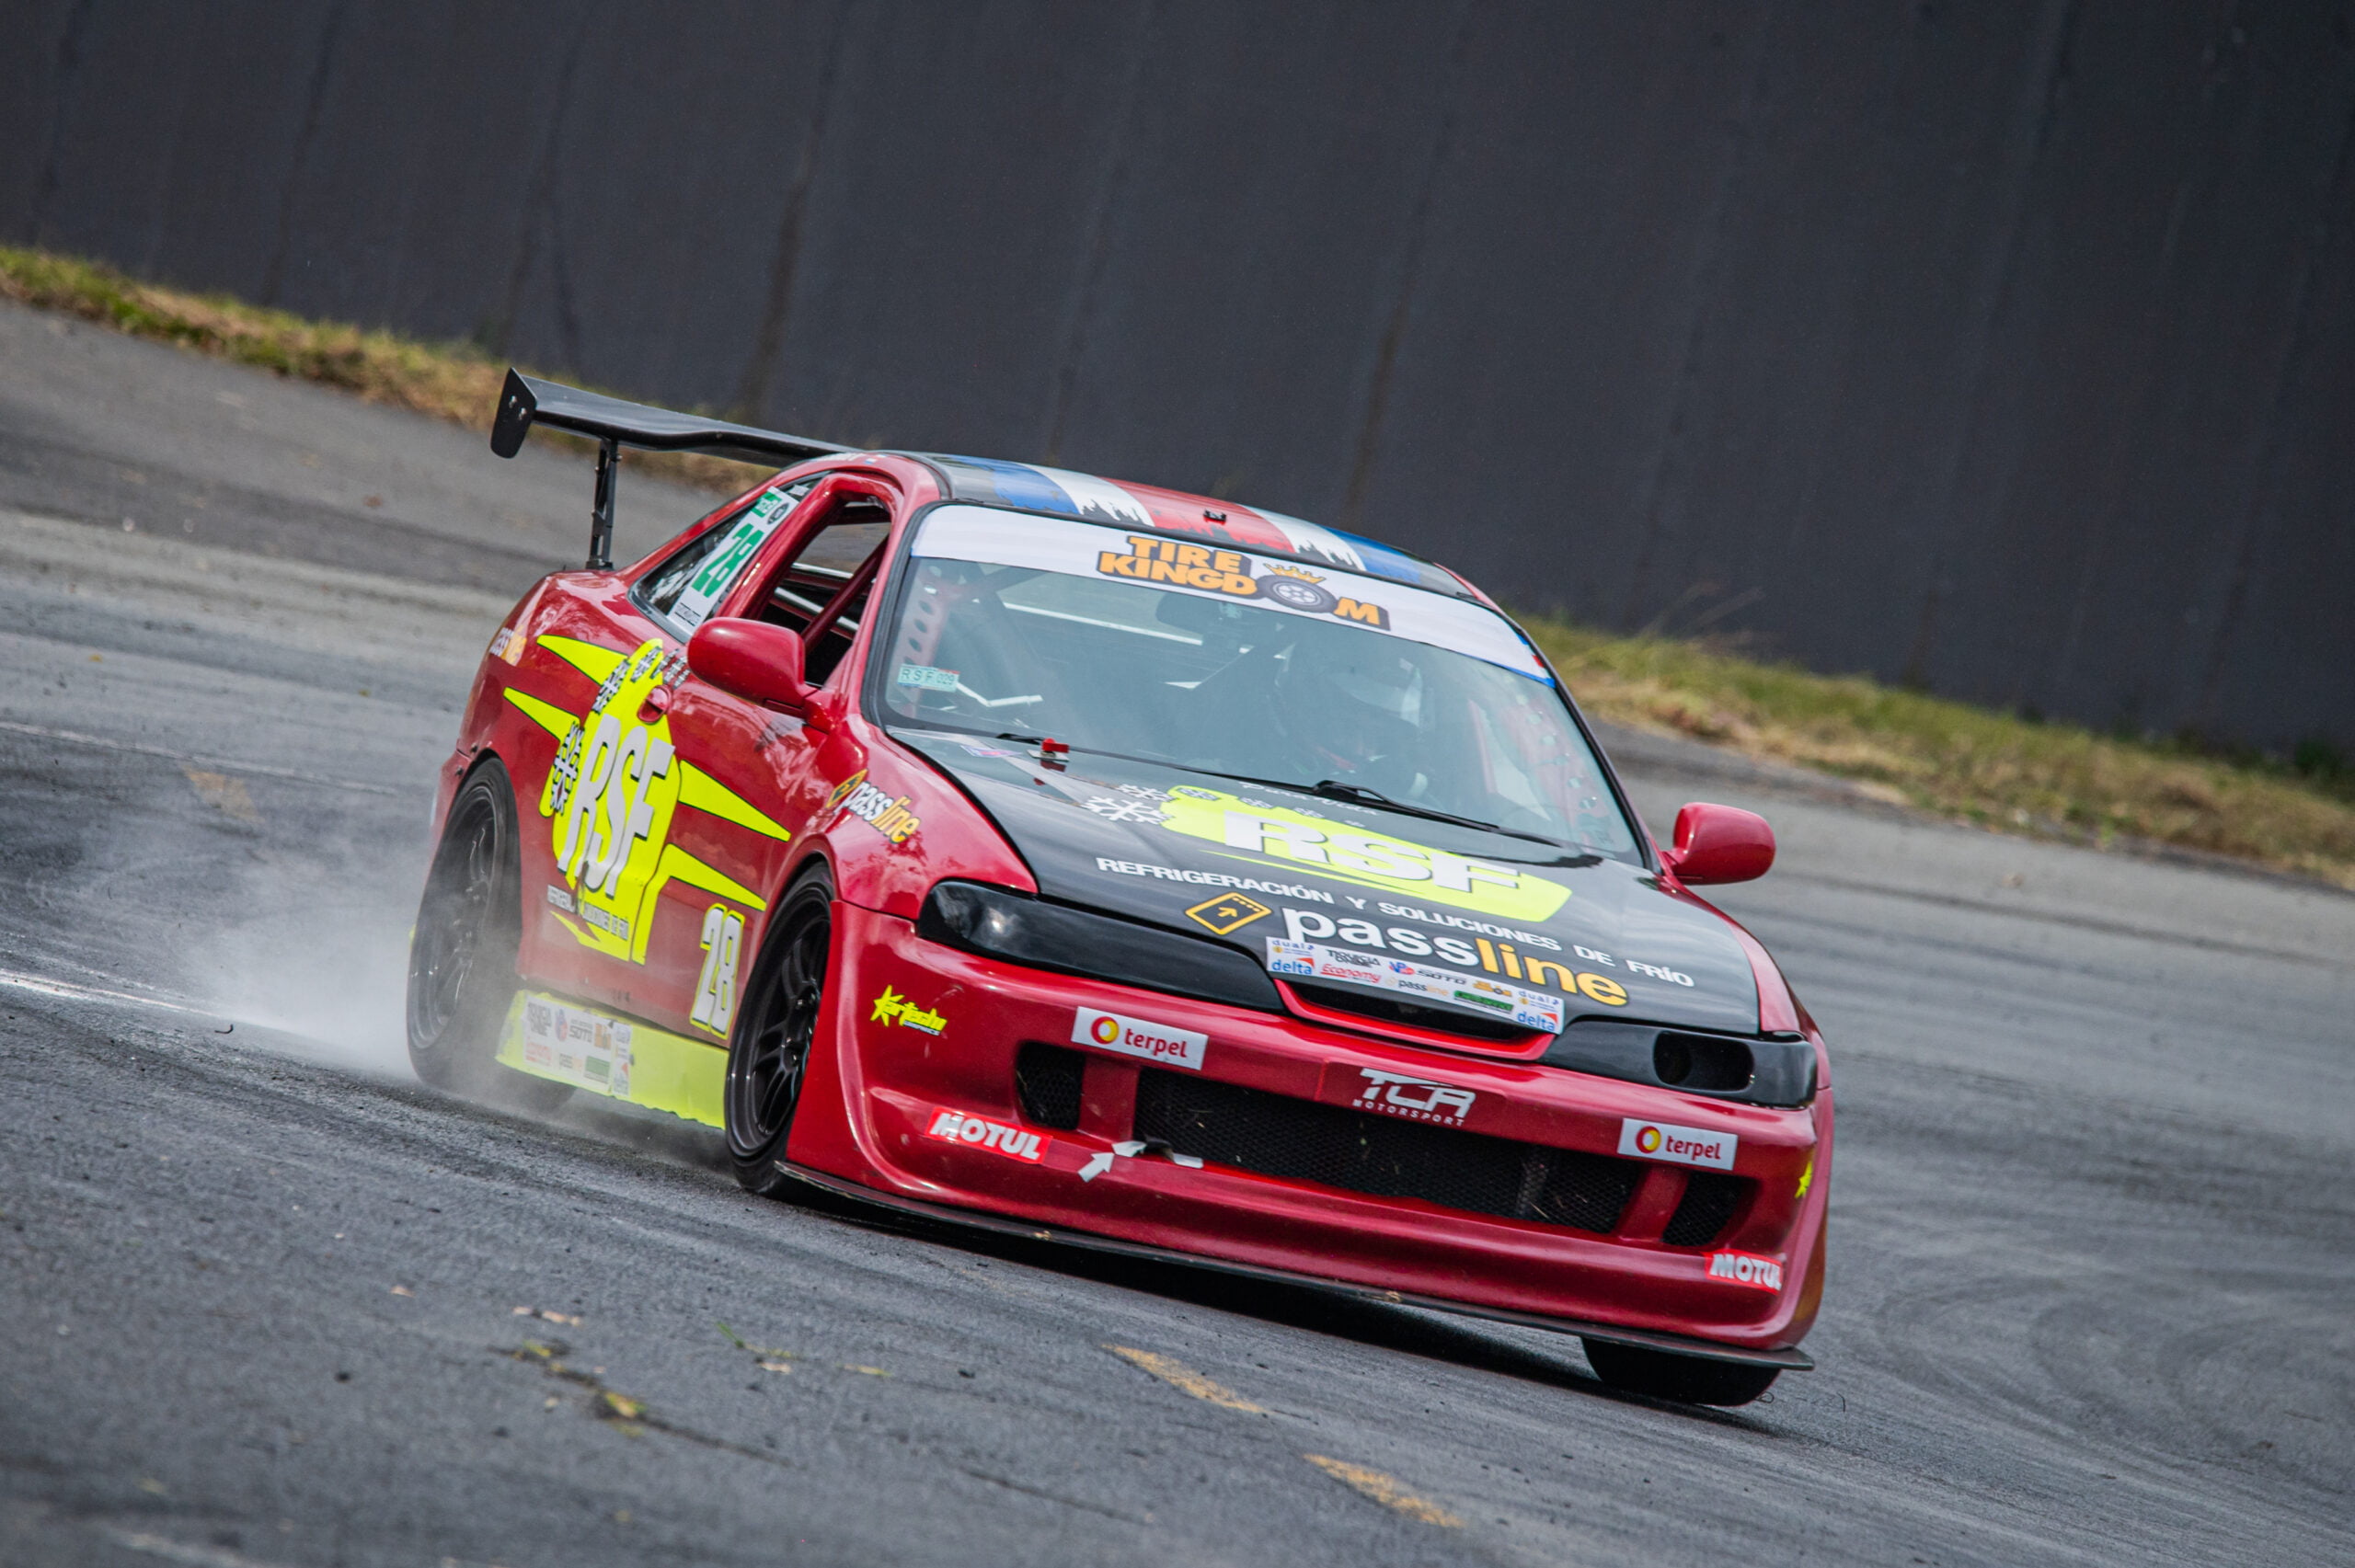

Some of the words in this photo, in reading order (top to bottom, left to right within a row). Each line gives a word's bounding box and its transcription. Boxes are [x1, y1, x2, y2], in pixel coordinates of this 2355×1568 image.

[1126, 535, 1244, 575] TIRE
[557, 713, 676, 900] RSF
[833, 781, 921, 844] passline
[1223, 809, 1523, 894] RSF
[1096, 857, 1336, 904] REFRIGERACIÓN
[1345, 896, 1367, 911] Y
[1377, 901, 1563, 952] SOLUCIONES
[1573, 944, 1616, 967] DE
[1626, 959, 1695, 988] FRÍO
[691, 905, 743, 1037] 28
[1271, 959, 1313, 975] delta
[1281, 906, 1629, 1008] passline
[1322, 963, 1382, 984] Economy
[1398, 979, 1449, 996] passline
[1517, 1012, 1557, 1032] delta
[1123, 1027, 1188, 1059] terpel
[1352, 1098, 1465, 1127] MOTORSPORT
[929, 1112, 1043, 1162] MOTUL
[1666, 1135, 1721, 1162] terpel
[1708, 1253, 1783, 1291] MOTUL
